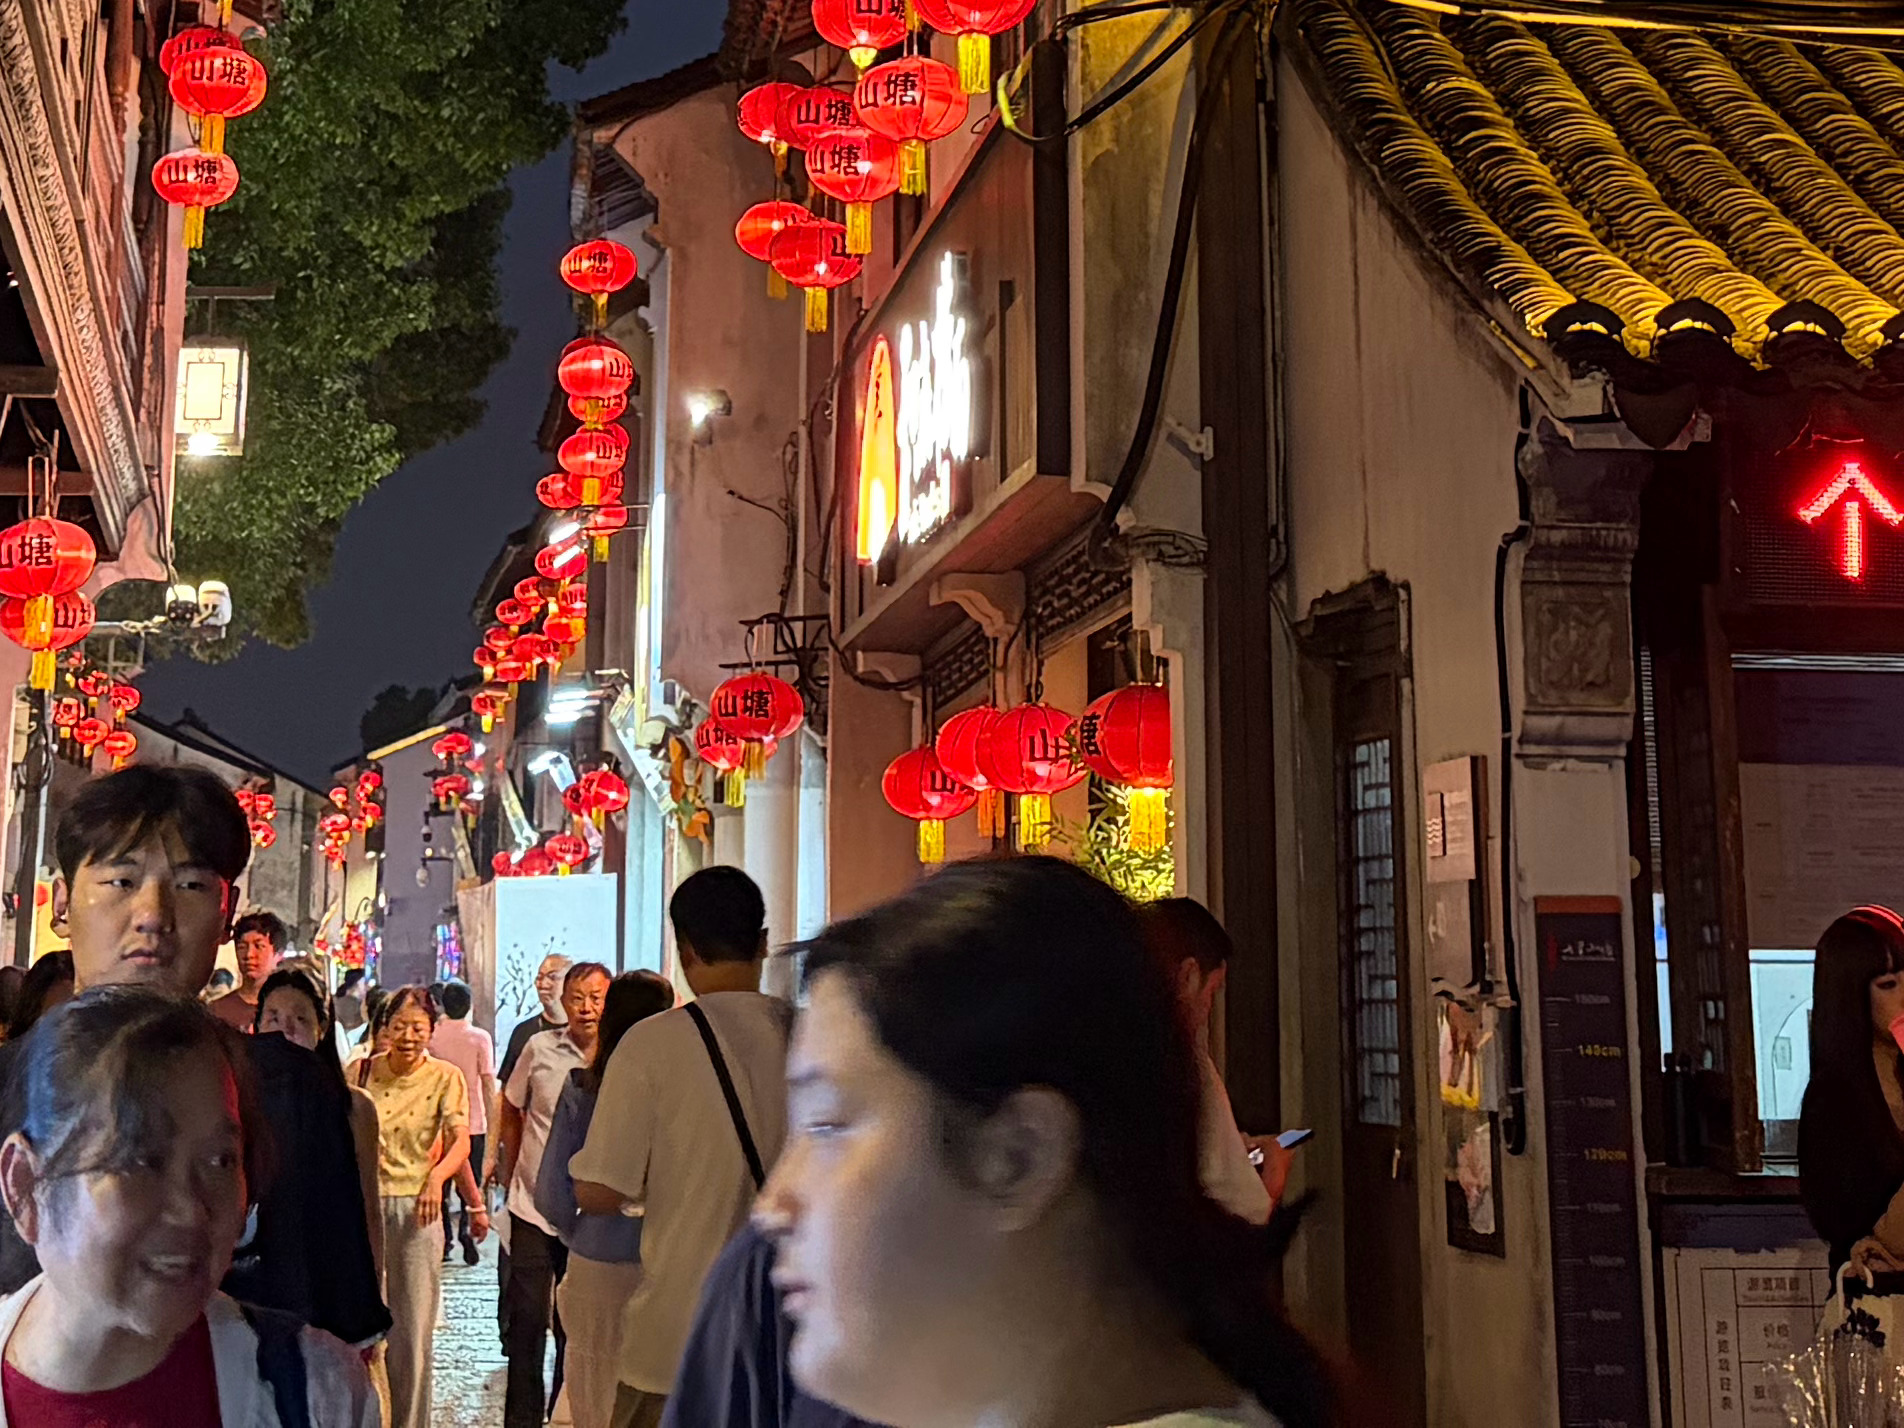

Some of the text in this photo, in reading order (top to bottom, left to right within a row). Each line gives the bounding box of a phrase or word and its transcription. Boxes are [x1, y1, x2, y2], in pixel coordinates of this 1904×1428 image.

[191, 56, 248, 86] 山塘
[859, 71, 919, 109] 山塘
[797, 98, 853, 127] 山塘
[167, 159, 217, 185] 山塘
[808, 143, 862, 176] 山塘
[717, 689, 773, 719] 山塘
